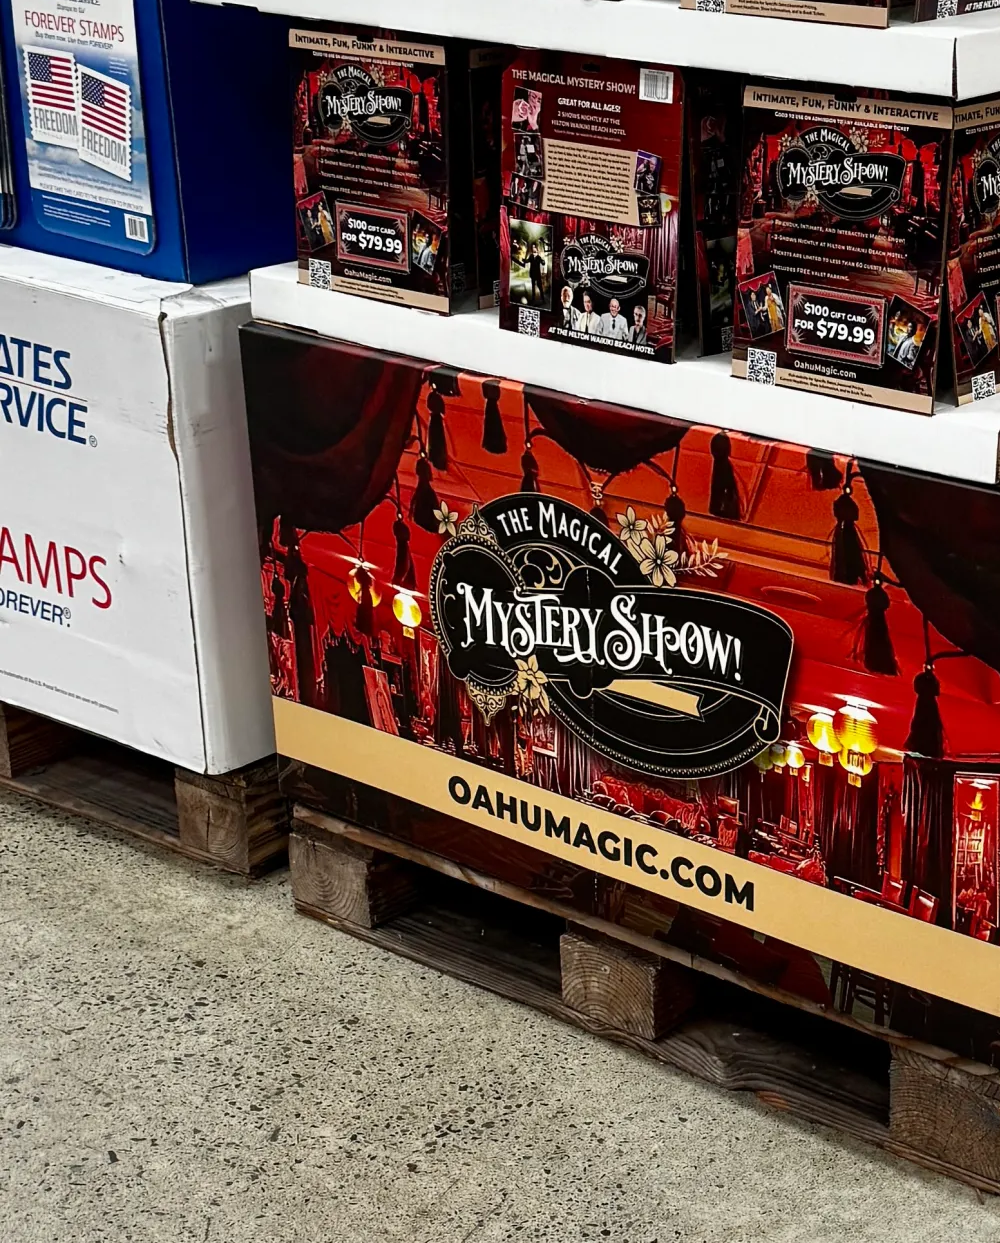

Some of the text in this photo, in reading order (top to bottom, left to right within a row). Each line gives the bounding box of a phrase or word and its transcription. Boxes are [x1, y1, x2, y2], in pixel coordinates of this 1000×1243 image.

[79, 19, 125, 42] STAMPS
[752, 91, 800, 107] INTIMATE,
[802, 97, 825, 110] FUN,
[827, 99, 860, 113] FUNNY
[864, 104, 871, 114] &
[873, 105, 939, 121] INTERACTIVE
[34, 107, 78, 136] FREEDOM
[82, 126, 126, 167] FREEDOM
[804, 128, 850, 152] THE MAGICAL
[786, 157, 889, 187] MYSTERY SHOW!
[804, 302, 867, 324] $100 GIFT CARD
[794, 318, 875, 346] FOR $79.99
[794, 360, 857, 379] OahuMagic.com
[497, 500, 621, 576] THE MAGICAL
[456, 581, 744, 682] MYSTERY SHOW!
[448, 774, 755, 912] OAHUMAGIC.COM
